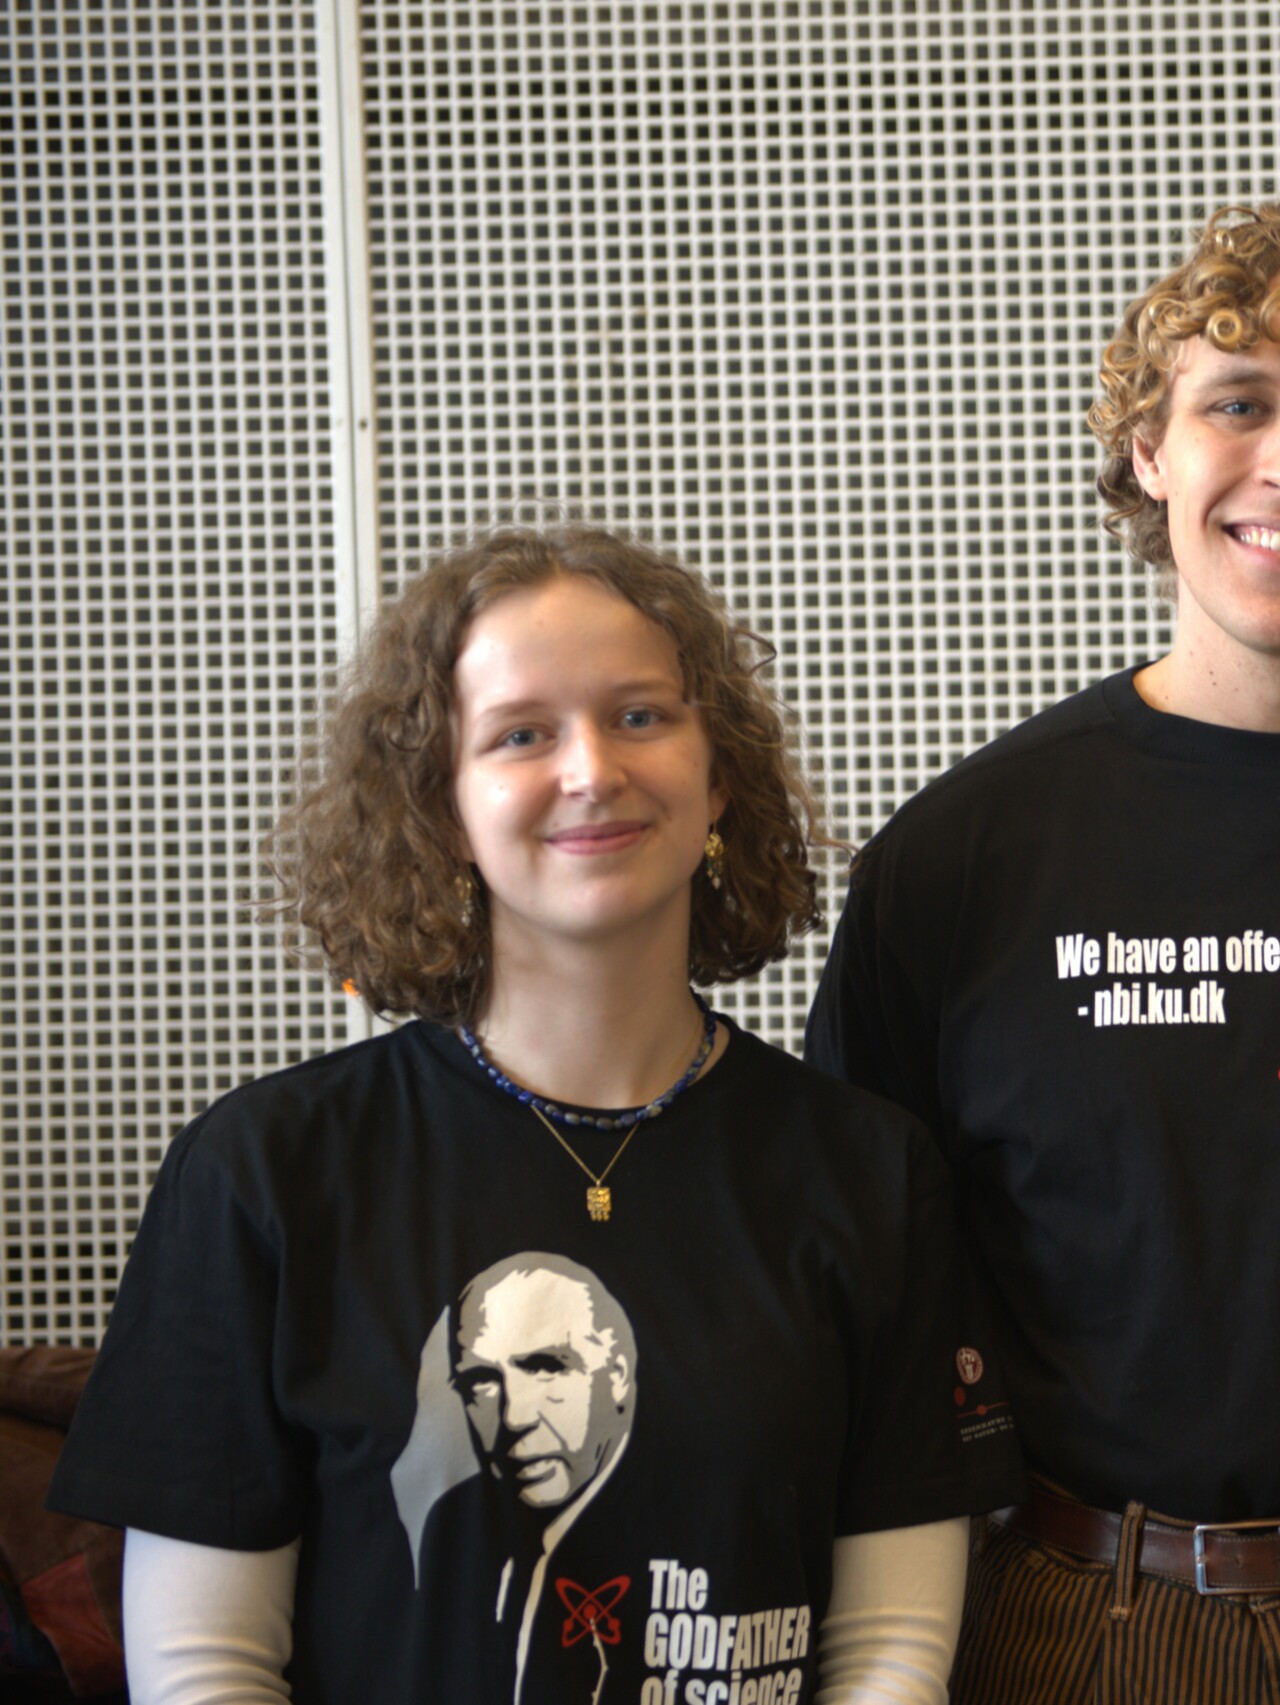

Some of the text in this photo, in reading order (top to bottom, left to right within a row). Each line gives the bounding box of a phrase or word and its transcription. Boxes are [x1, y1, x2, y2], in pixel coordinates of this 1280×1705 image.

[1056, 933, 1101, 979] We
[1106, 931, 1177, 975] have
[1183, 935, 1220, 974] an
[649, 1559, 709, 1611] The
[644, 1605, 811, 1671] GODFATHER
[640, 1667, 803, 1705] of science
